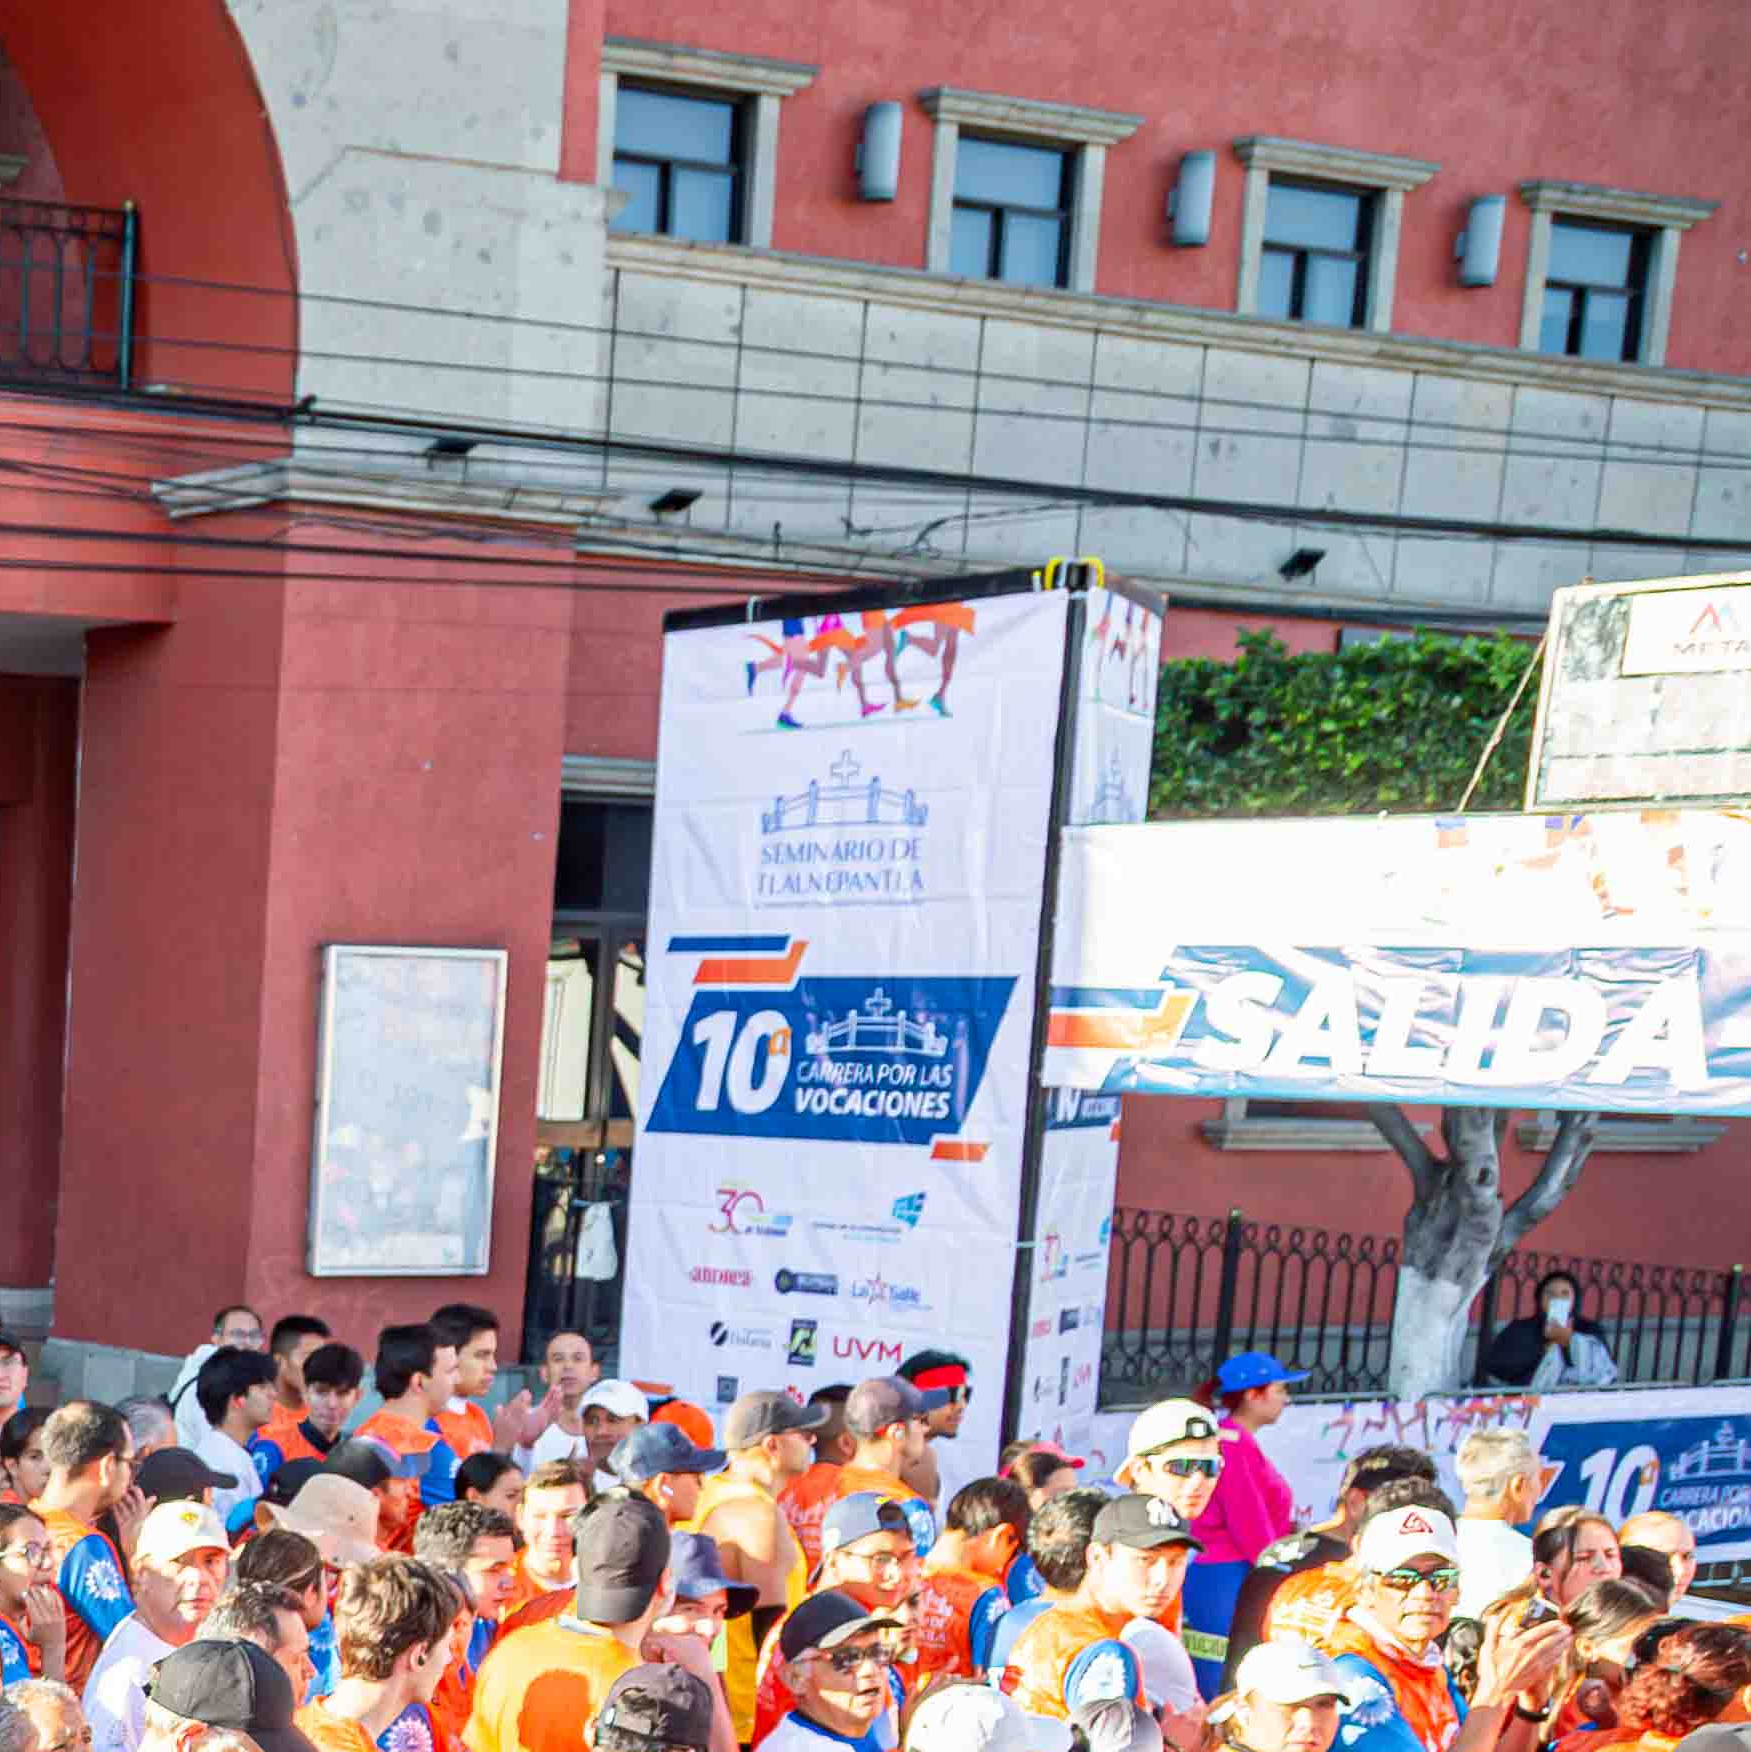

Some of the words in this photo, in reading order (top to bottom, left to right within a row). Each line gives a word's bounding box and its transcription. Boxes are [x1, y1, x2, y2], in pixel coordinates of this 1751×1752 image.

[761, 837, 885, 863] SEMINARIO
[891, 836, 922, 861] DE
[758, 868, 924, 896] TLALNEPANTLA
[1200, 958, 1710, 1093] SALIDA
[797, 1059, 876, 1086] CARRERA
[877, 1062, 917, 1086] POR
[920, 1062, 954, 1086] LAS
[796, 1087, 950, 1120] VOCACIONES
[833, 1334, 904, 1363] UVM
